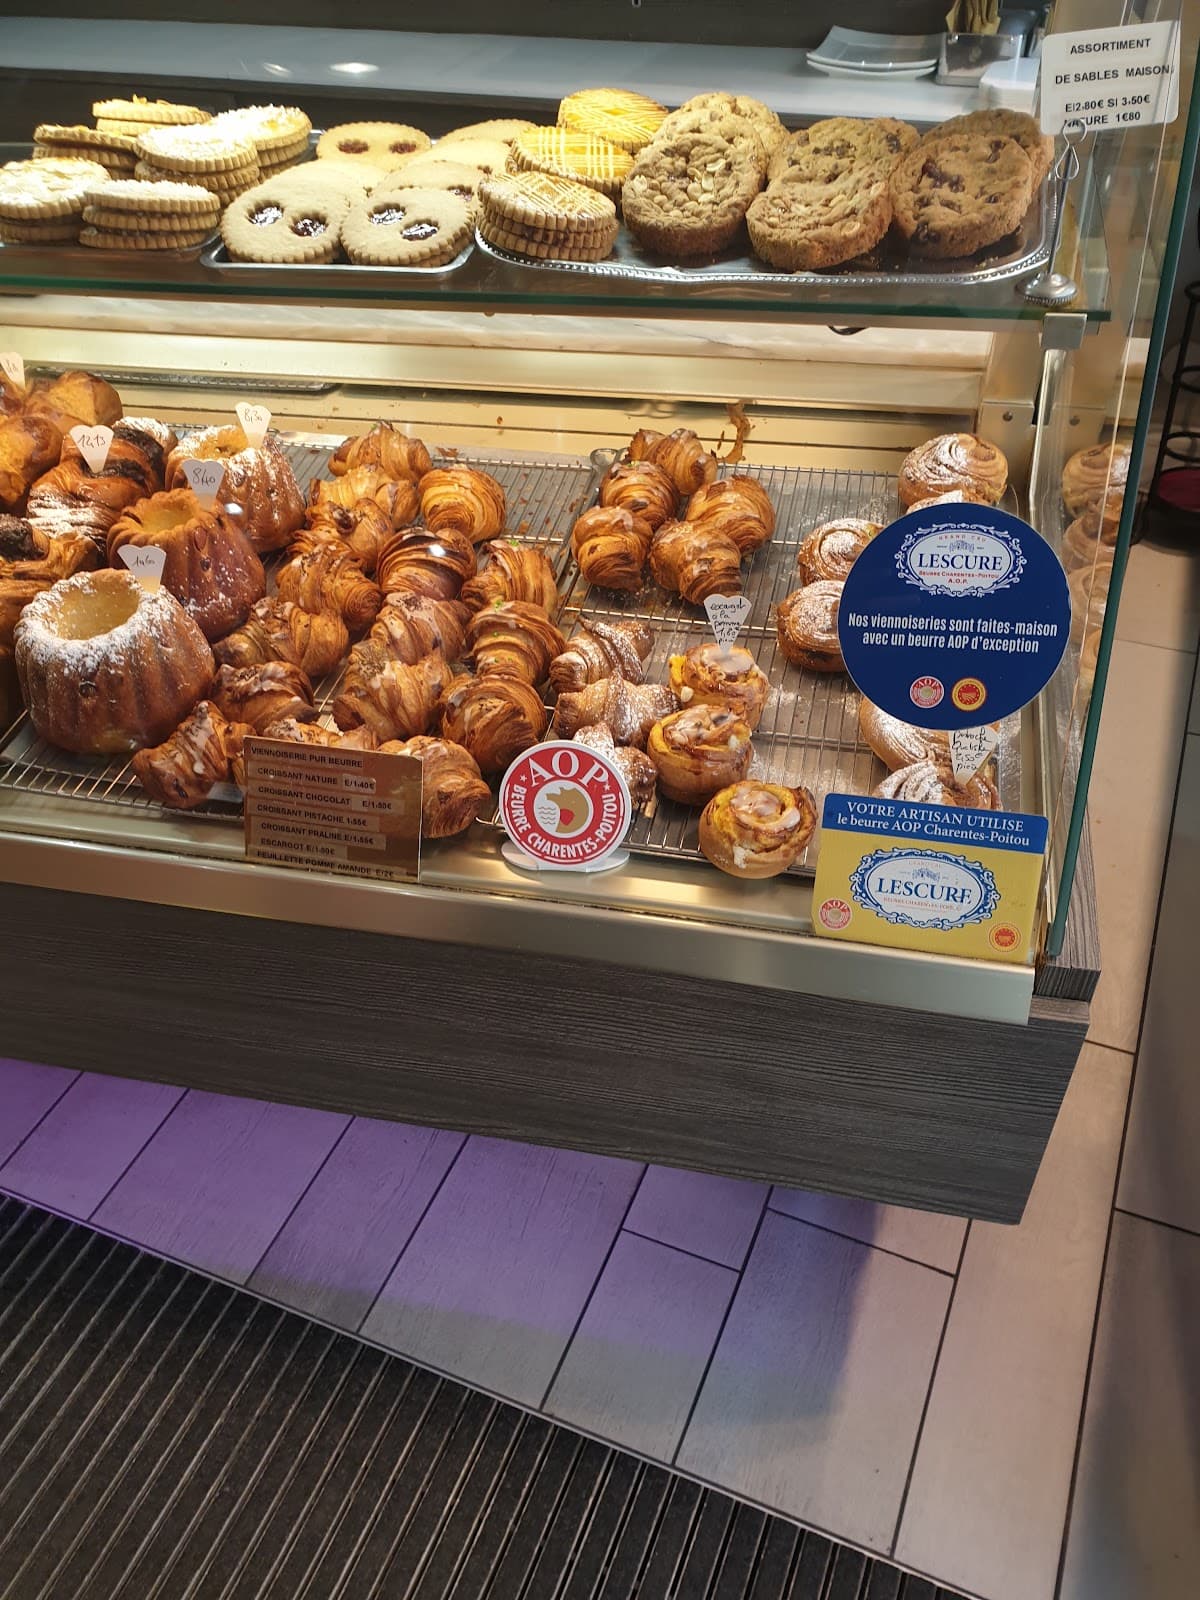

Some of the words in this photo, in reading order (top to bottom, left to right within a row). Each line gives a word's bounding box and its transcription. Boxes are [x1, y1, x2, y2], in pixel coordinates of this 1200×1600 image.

[1070, 38, 1151, 55] ASSORTIMENT
[1055, 74, 1071, 85] DE
[1073, 69, 1119, 83] SABLES
[1125, 64, 1170, 78] MAISON
[1121, 94, 1151, 106] 3.50€
[1116, 111, 1141, 123] 1€80
[917, 553, 1003, 571] LESCURE
[848, 612, 869, 628] Nos
[870, 613, 948, 631] viennoiseries
[948, 617, 975, 633] sont
[976, 618, 1058, 637] faites-maison
[862, 632, 889, 646] avec
[891, 634, 906, 647] un
[907, 633, 946, 649] beurre
[947, 635, 970, 650] AOP
[309, 754, 327, 763] PUR
[528, 749, 609, 787] AOP
[257, 767, 303, 780] CROISSANT
[305, 774, 338, 785] NATURE
[258, 786, 304, 799] CROISSANT
[305, 793, 351, 806] CHOCOLAT
[257, 804, 303, 817] CROISSANT
[304, 811, 344, 824] PISTACHE
[510, 784, 532, 834] BEURRE
[527, 793, 618, 858] CHARENTES-POITOU
[847, 801, 896, 817] VOTRE
[898, 807, 963, 825] ARTISAN
[967, 815, 1024, 832] UTILISE
[261, 822, 307, 836] CROISSANT
[307, 829, 342, 841] PRALINE
[837, 814, 848, 825] le
[850, 815, 890, 830] beurre
[891, 820, 922, 833] AOP
[923, 824, 1031, 847] Charentes-Poitou
[876, 877, 972, 905] LESCURE
